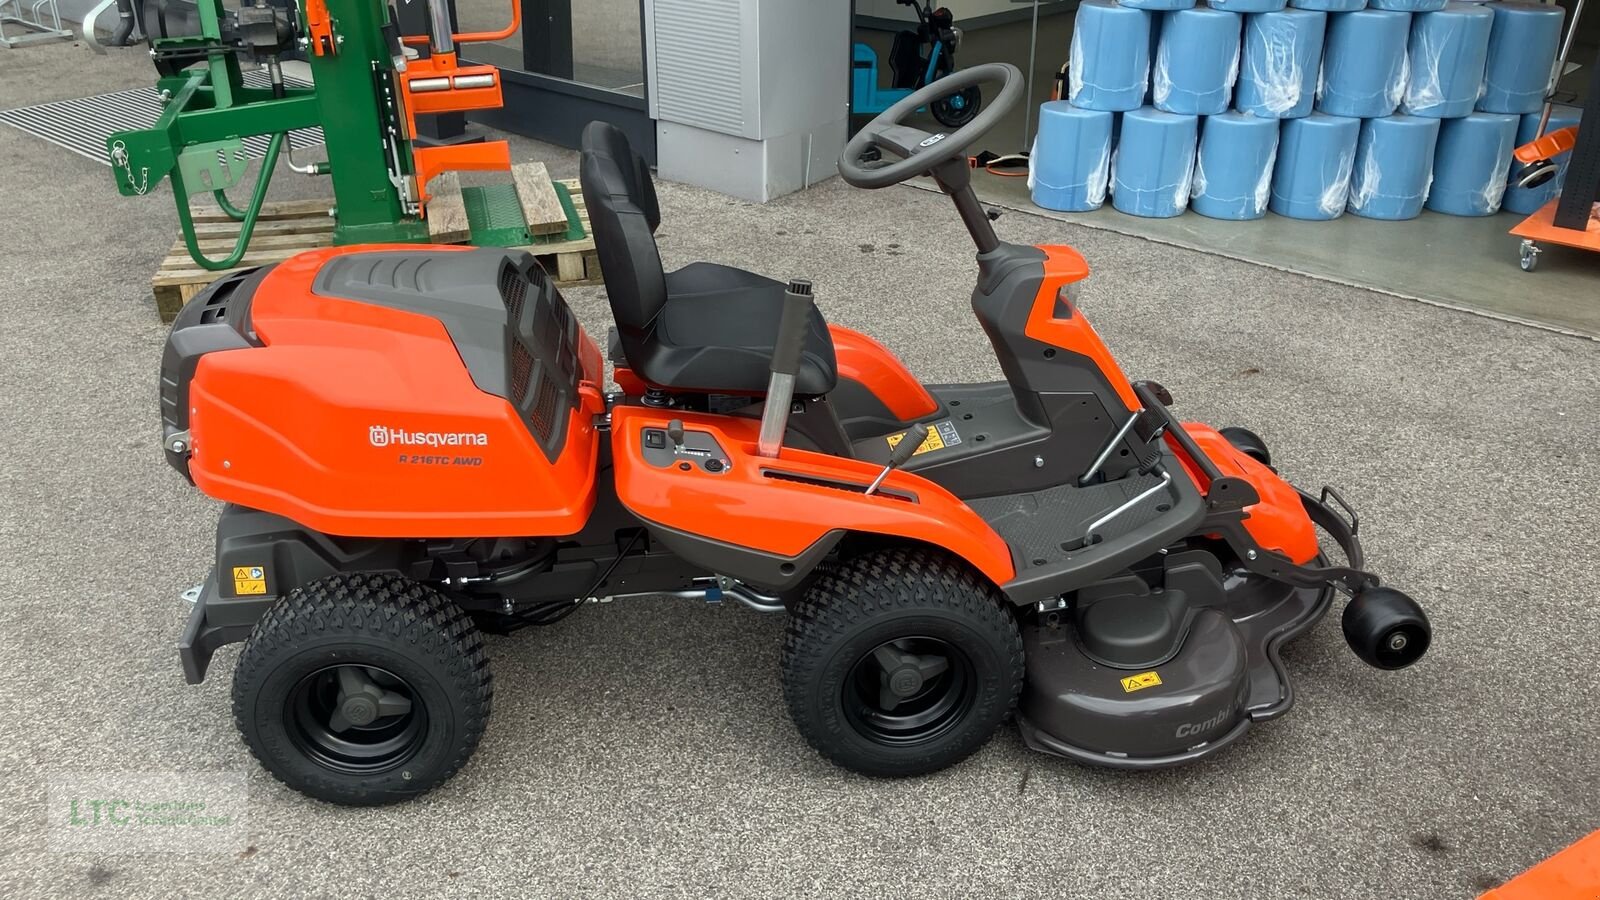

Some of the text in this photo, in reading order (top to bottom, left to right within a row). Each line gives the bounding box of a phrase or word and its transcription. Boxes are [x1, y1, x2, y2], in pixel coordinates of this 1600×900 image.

[390, 428, 488, 447] Husqvarna
[399, 454, 482, 466] R 216TC AWD
[1176, 704, 1231, 738] Combi
